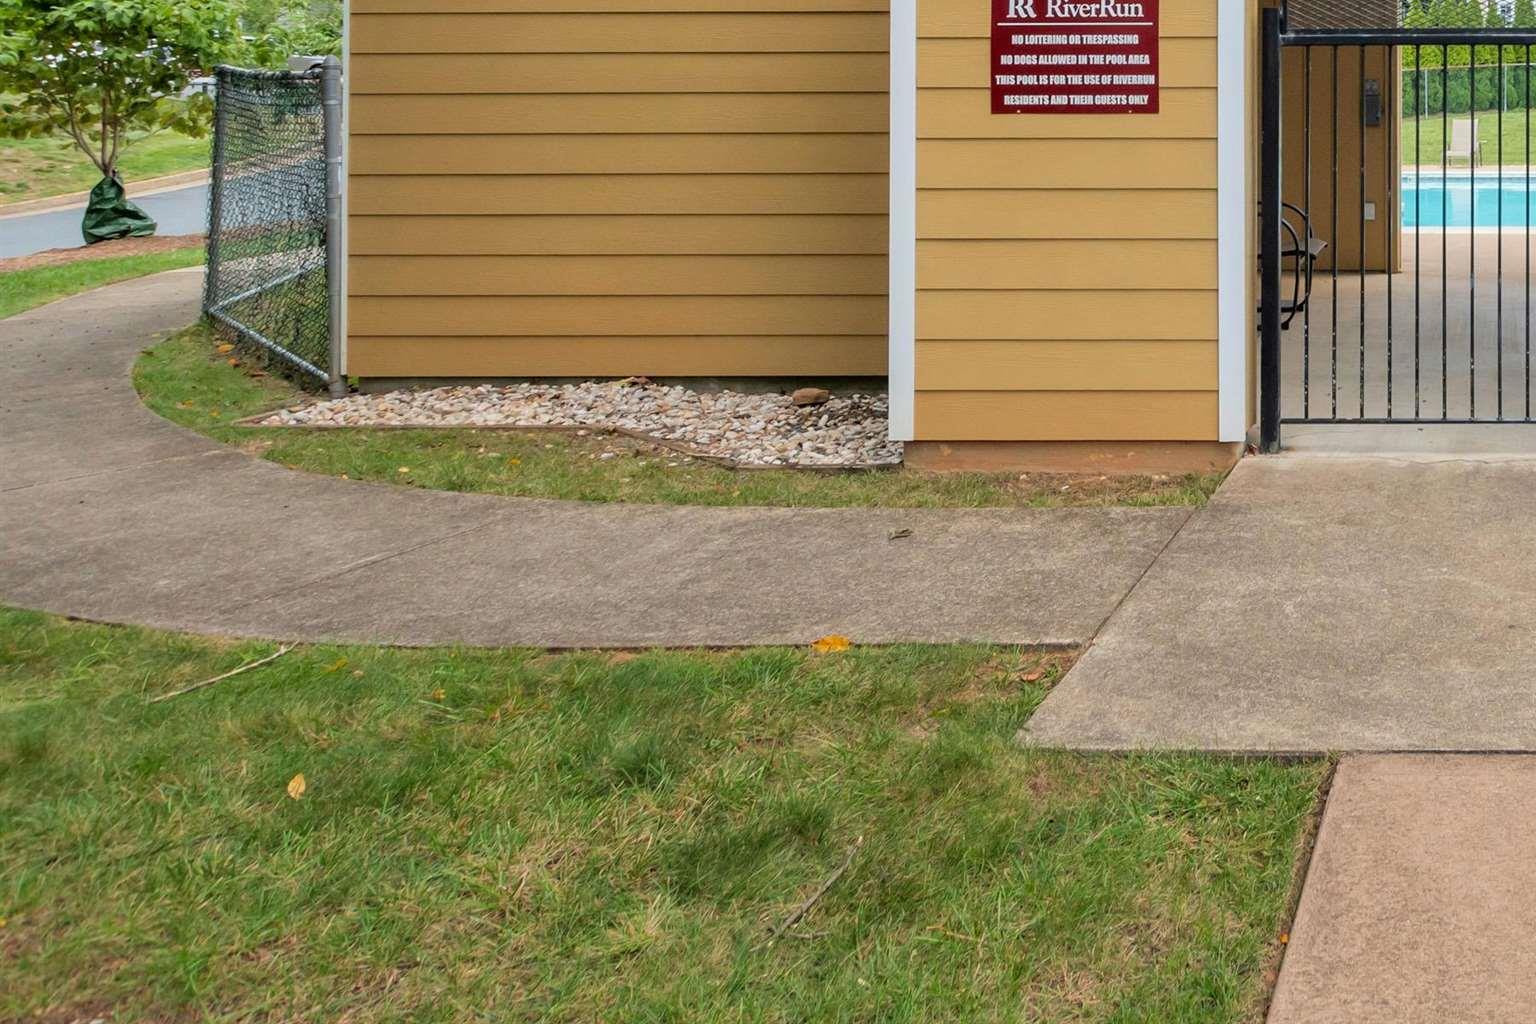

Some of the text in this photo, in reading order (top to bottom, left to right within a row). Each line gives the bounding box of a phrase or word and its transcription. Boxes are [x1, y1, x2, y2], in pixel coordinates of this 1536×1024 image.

[1012, 35, 1139, 44] NO LOITERING OR TRESPASSING
[1001, 55, 1150, 64] NO DOGS ALLOWED IN THE POOL AREA
[996, 75, 1155, 85] THIS POOL IS FOR THE USE OF RIVERRUN
[1004, 95, 1148, 105] RESIDENTS AND THEIR GUESTS ONLY
